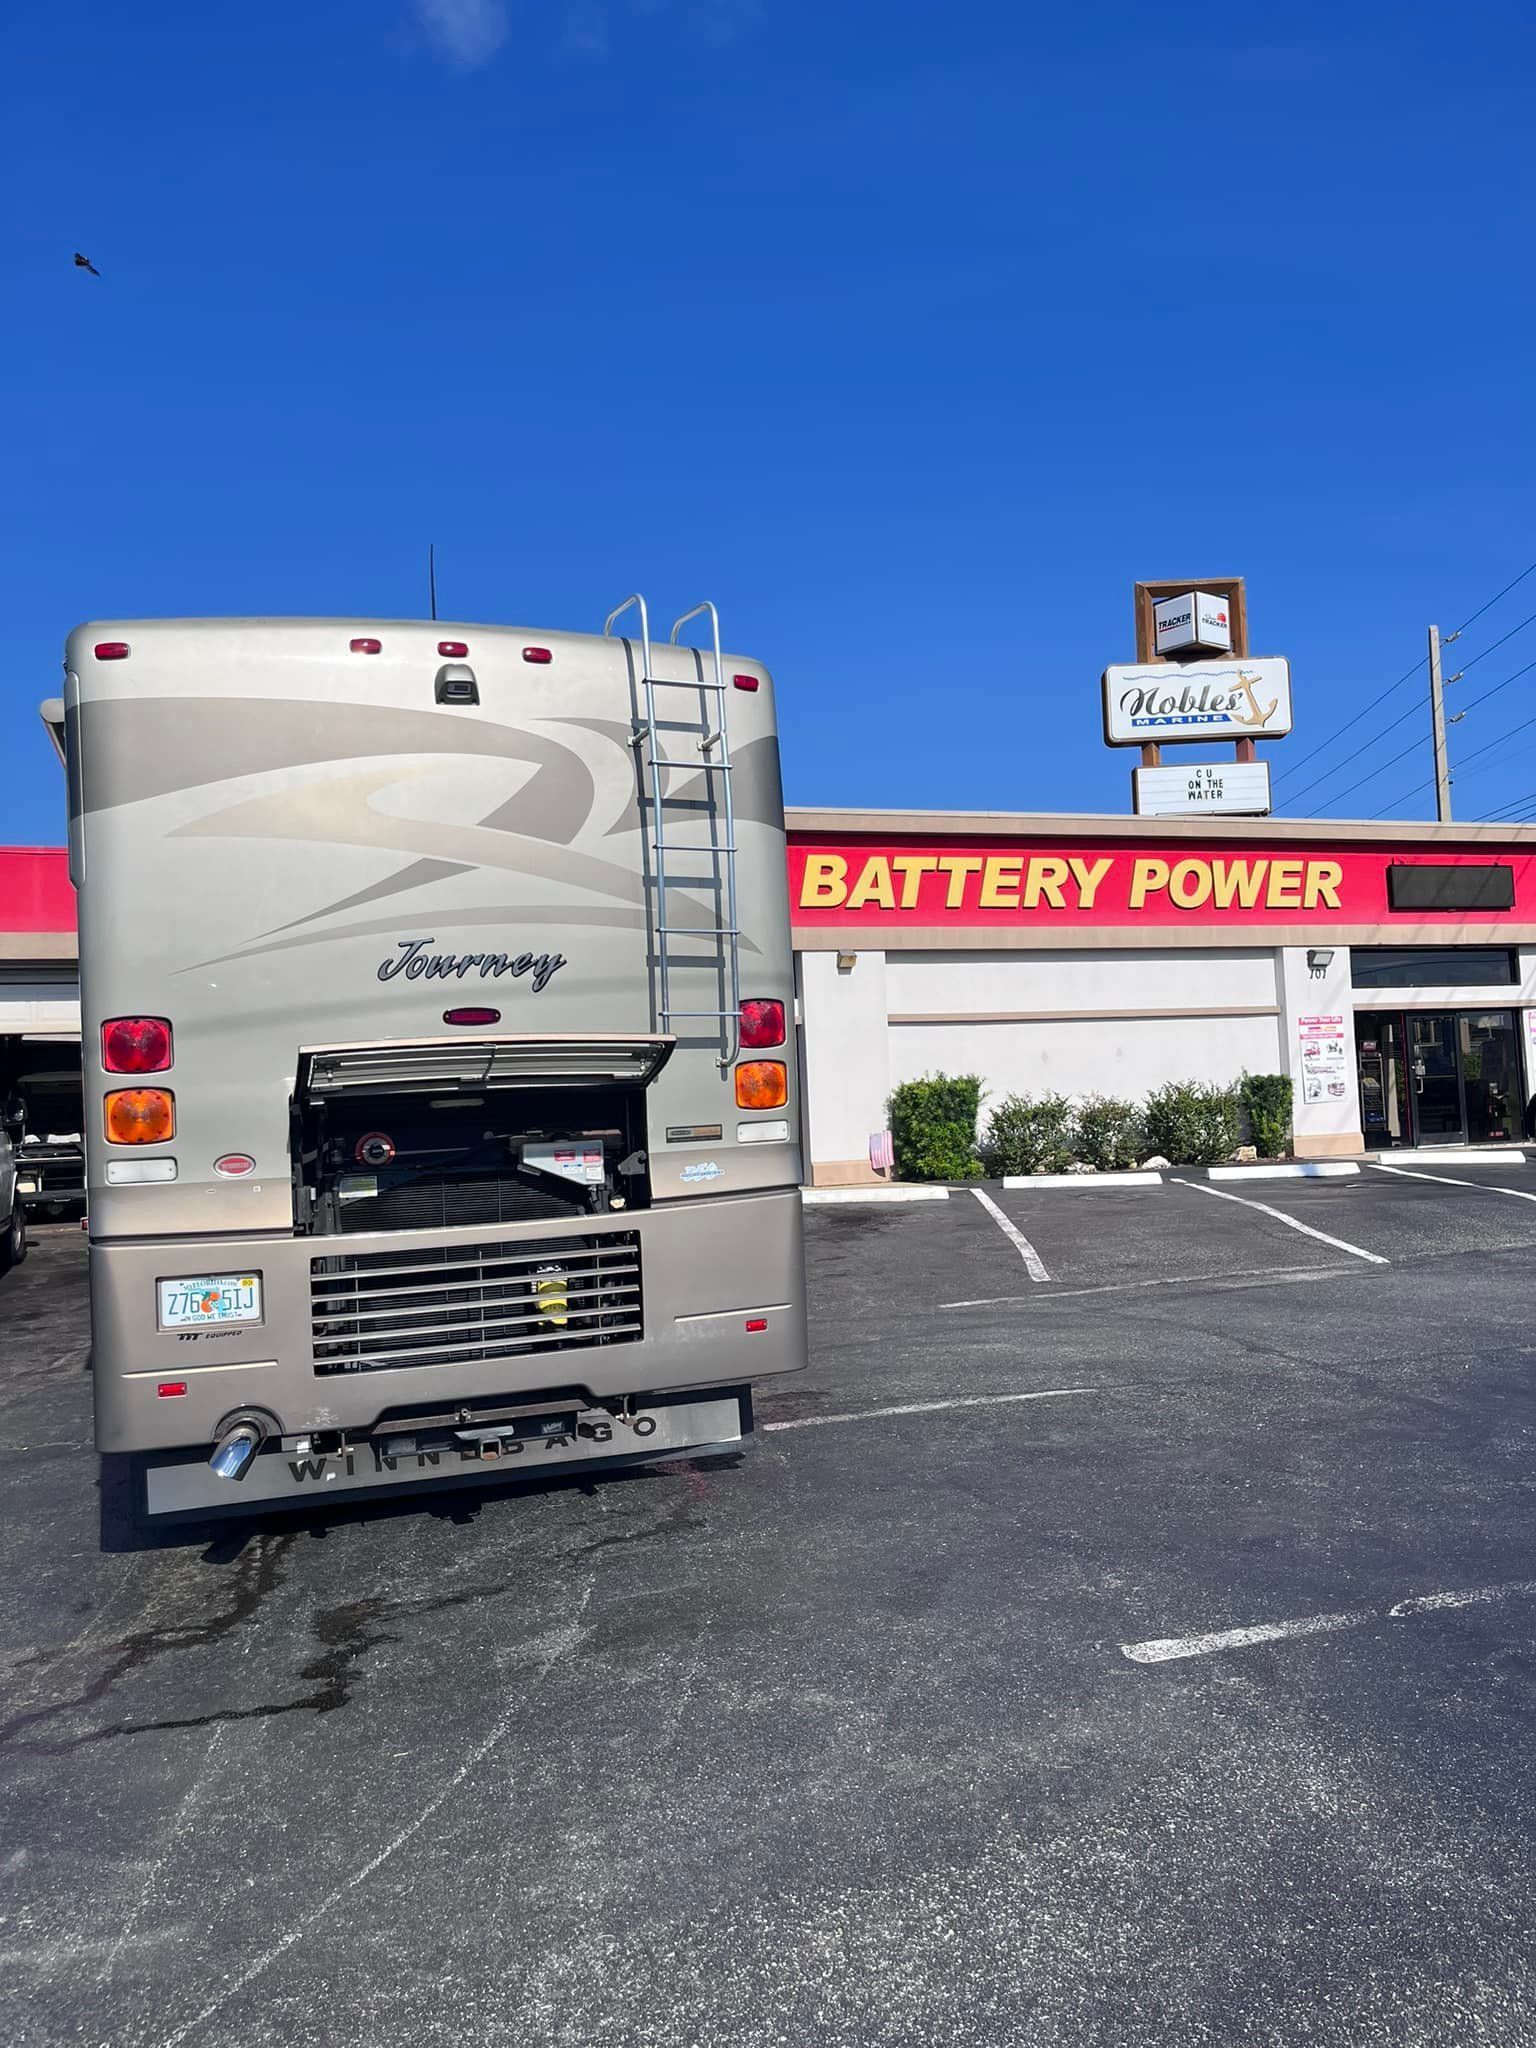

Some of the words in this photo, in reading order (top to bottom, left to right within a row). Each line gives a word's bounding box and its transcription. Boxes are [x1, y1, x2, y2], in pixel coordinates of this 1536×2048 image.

[1158, 613, 1191, 629] TRACKER
[1202, 618, 1227, 629] TRACKER
[1136, 715, 1224, 726] MARINE
[1196, 769, 1202, 778] C
[1206, 769, 1212, 778] U
[1188, 780, 1201, 789] ON
[1207, 779, 1223, 789] THE
[1188, 790, 1223, 800] WATER
[799, 854, 1115, 910] BATTERY
[1128, 858, 1343, 910] POWER
[377, 937, 567, 993] Journey
[168, 1292, 200, 1315] Z76
